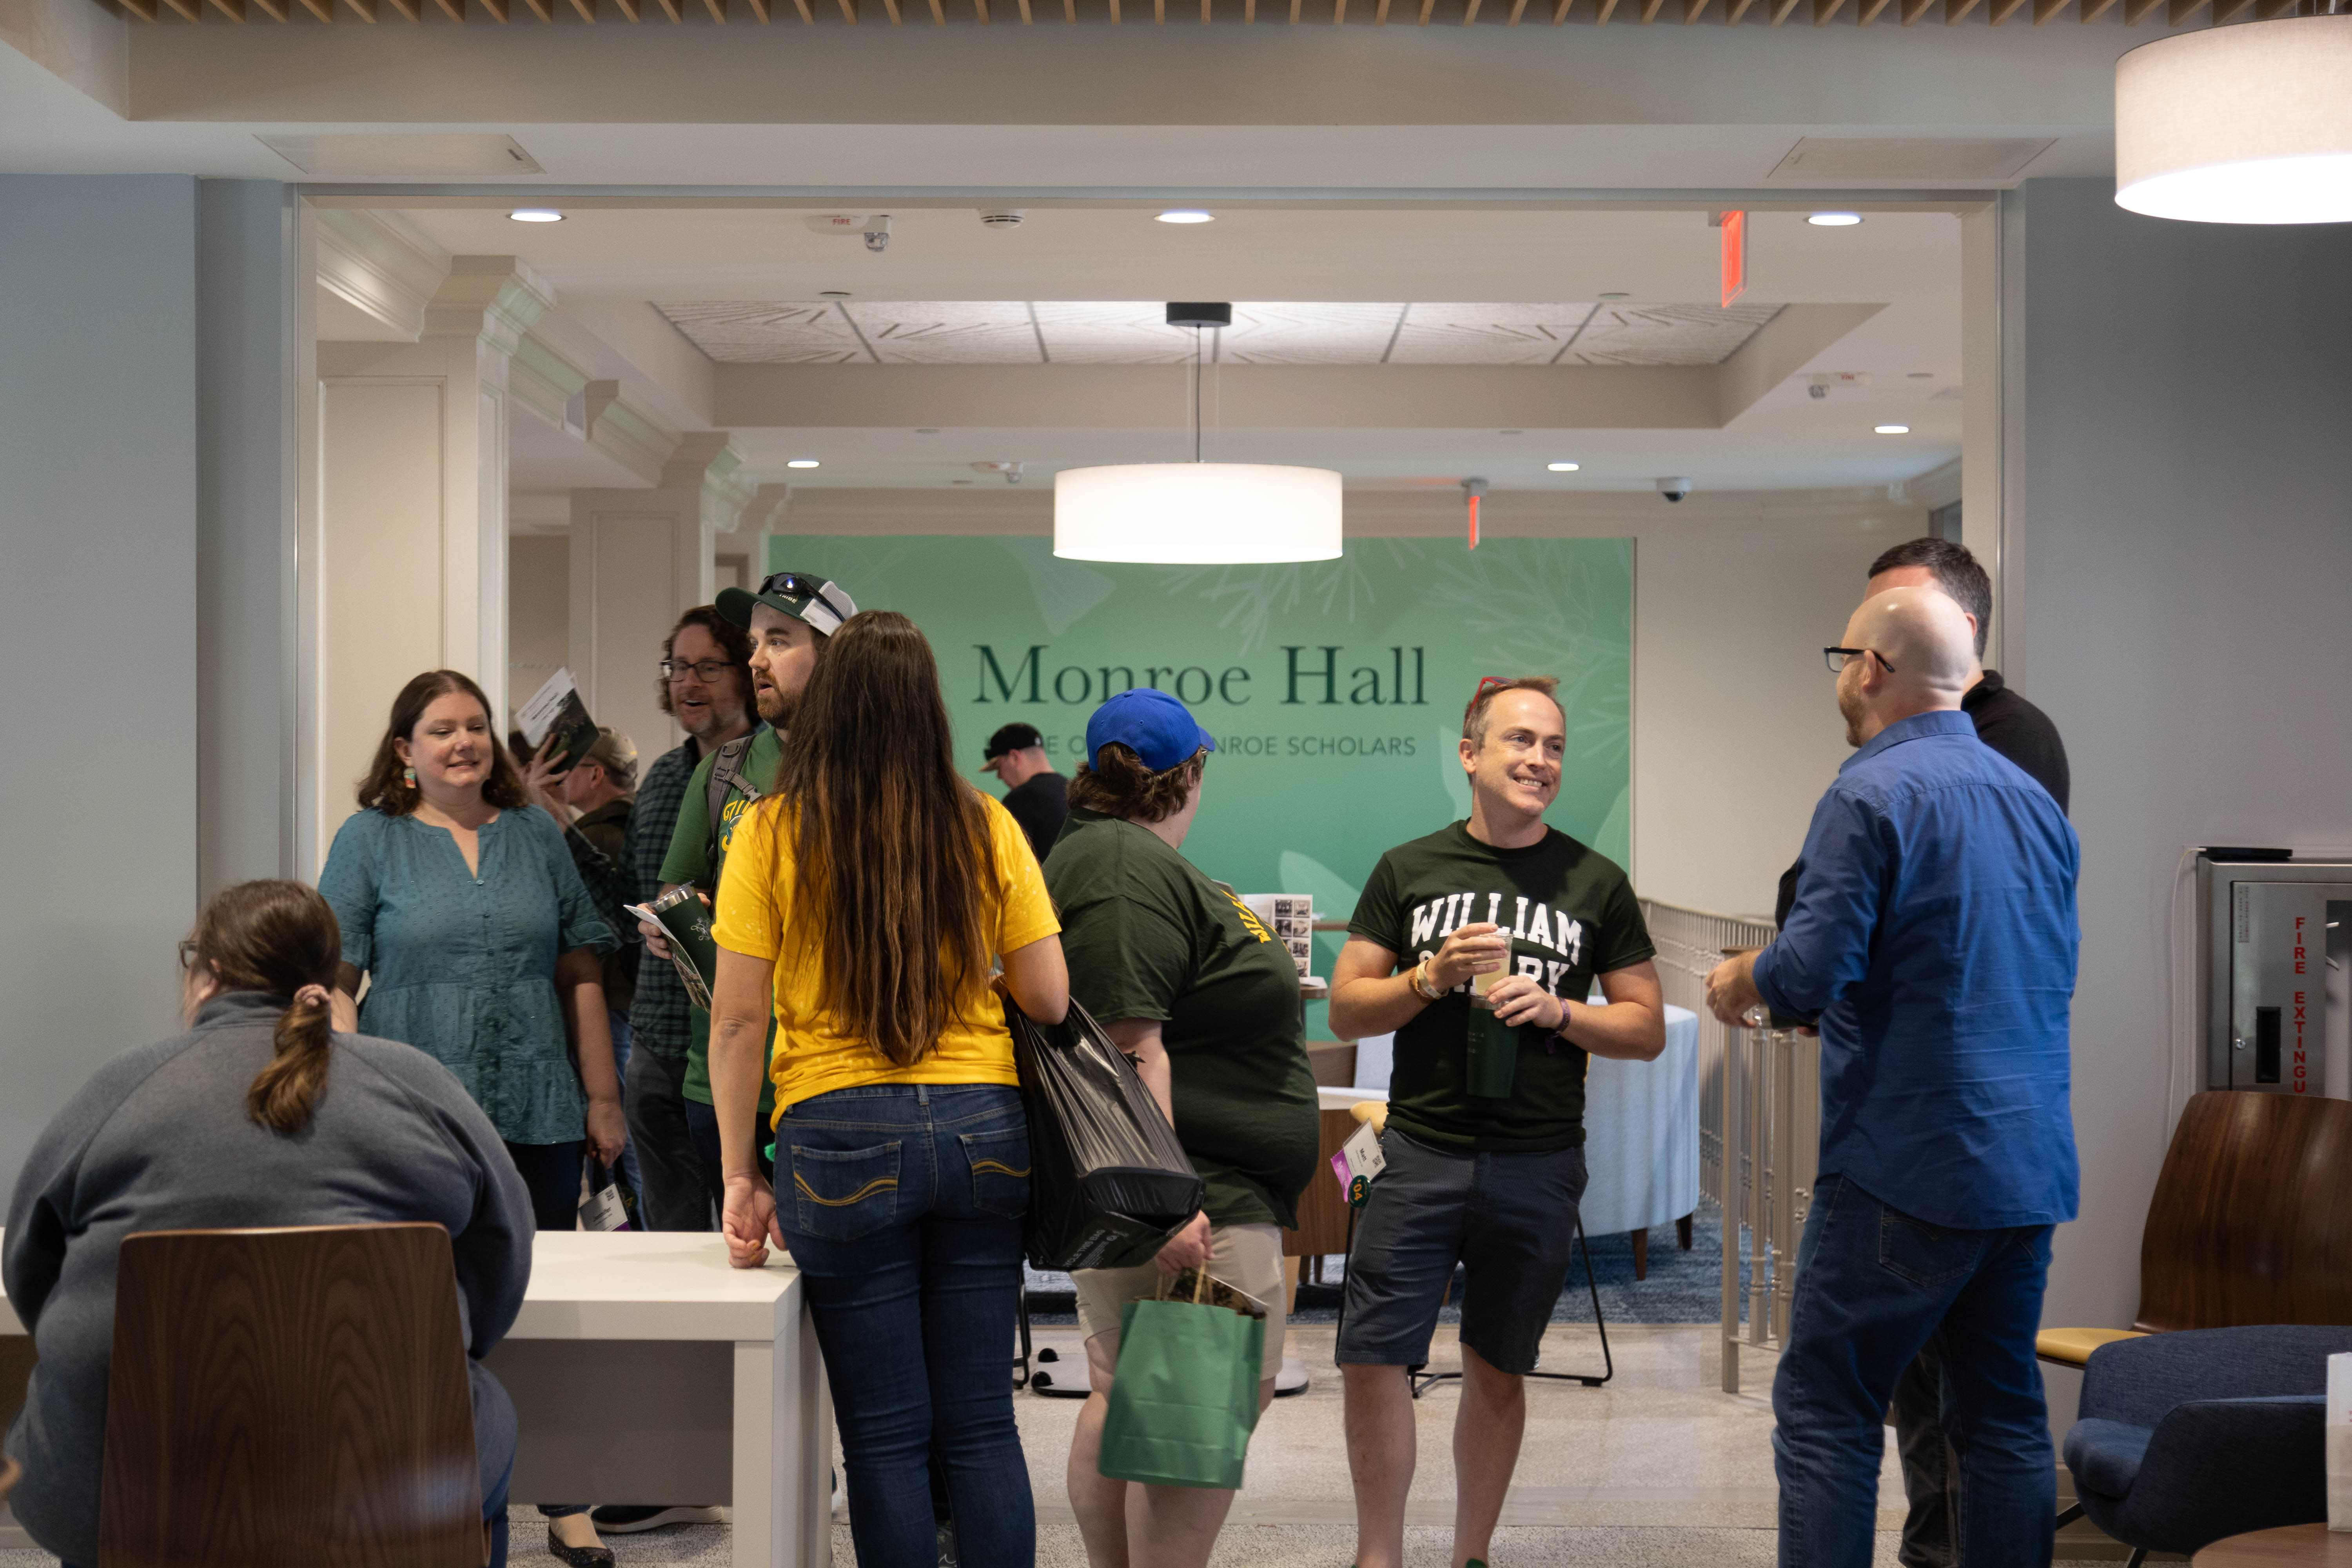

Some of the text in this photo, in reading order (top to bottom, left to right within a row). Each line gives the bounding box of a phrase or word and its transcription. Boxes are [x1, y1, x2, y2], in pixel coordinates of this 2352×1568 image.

[779, 593, 797, 604] TRIBE
[971, 644, 1430, 706] Monroe Hall
[1212, 736, 1277, 756] NROE
[1288, 736, 1416, 756] SCHOLARS
[1412, 892, 1582, 965] WILLIAM
[2294, 917, 2306, 1093] FIRE EXTINGU
[1063, 1253, 1082, 1267] YCLE
[1089, 1229, 1106, 1242] BAG
